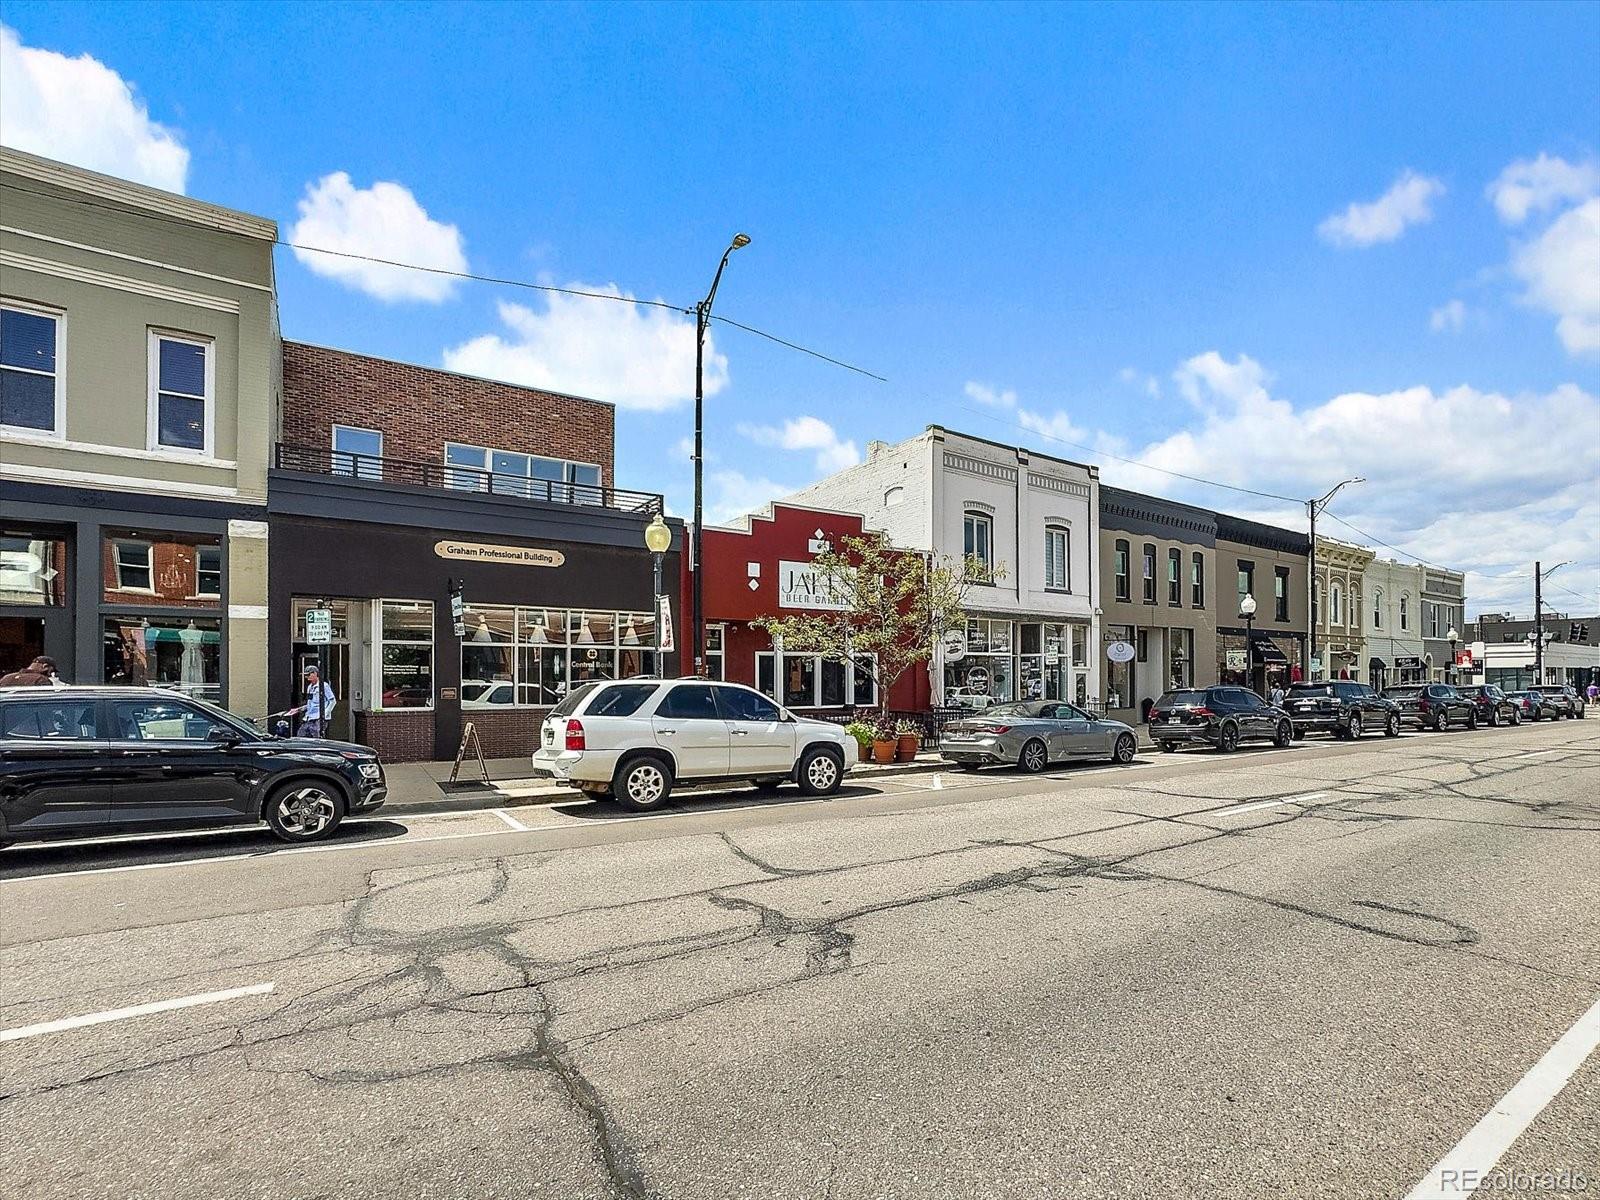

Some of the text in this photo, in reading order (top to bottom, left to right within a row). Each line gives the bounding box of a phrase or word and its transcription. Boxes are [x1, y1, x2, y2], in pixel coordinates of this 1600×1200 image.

[447, 545, 553, 563] Graham Professional Building
[786, 594, 810, 603] BEER
[308, 612, 314, 622] 2
[571, 660, 613, 669] Central Bank
